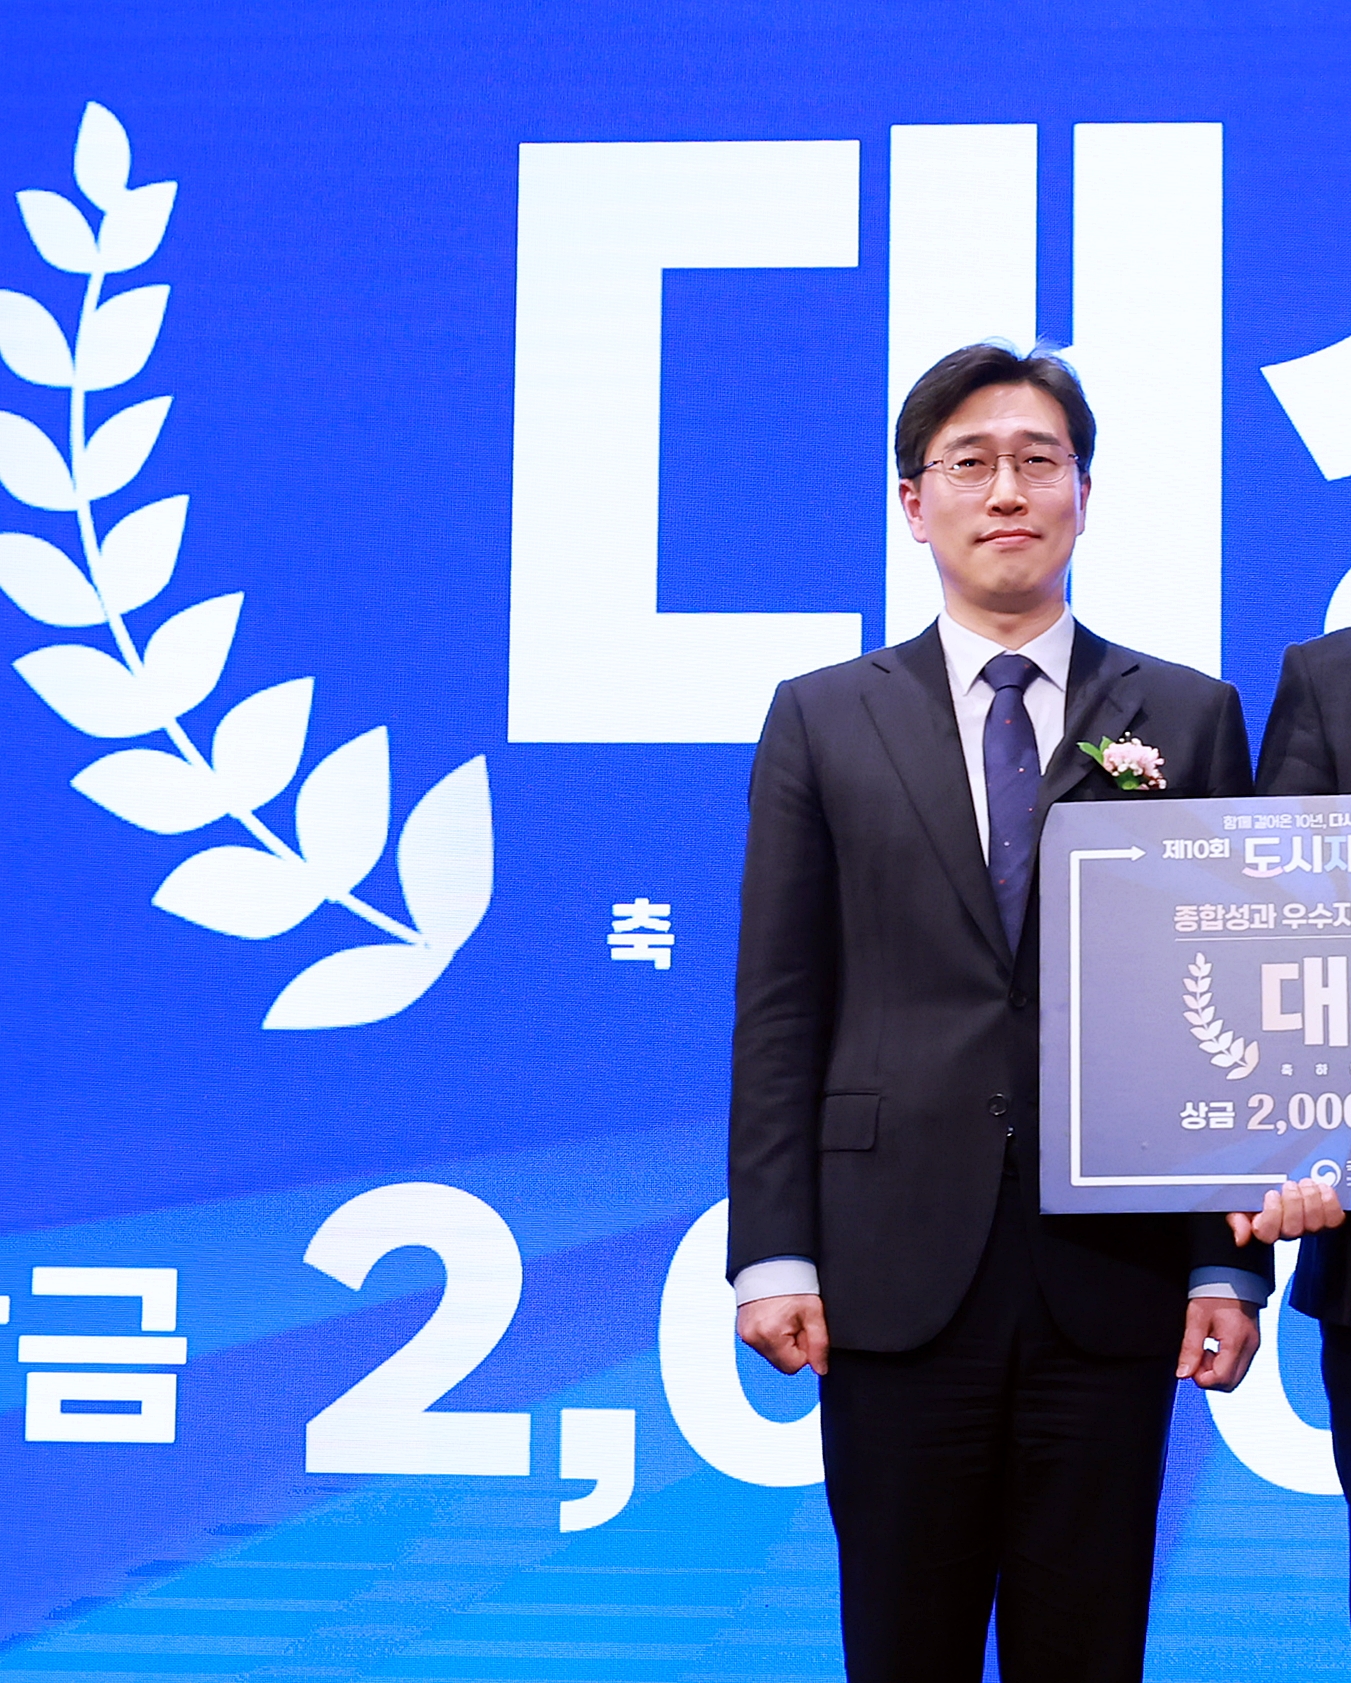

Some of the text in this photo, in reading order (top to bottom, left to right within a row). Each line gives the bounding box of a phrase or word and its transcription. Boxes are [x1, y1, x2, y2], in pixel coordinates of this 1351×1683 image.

[1223, 814, 1252, 830] 함께
[1253, 813, 1292, 829] 걸어온
[1295, 812, 1327, 829] 10년,
[1162, 837, 1230, 859] 제10회
[1173, 903, 1277, 932] 종합성과
[607, 898, 675, 970] 축
[1179, 1101, 1236, 1130] 상금
[0, 1267, 188, 1443] 금
